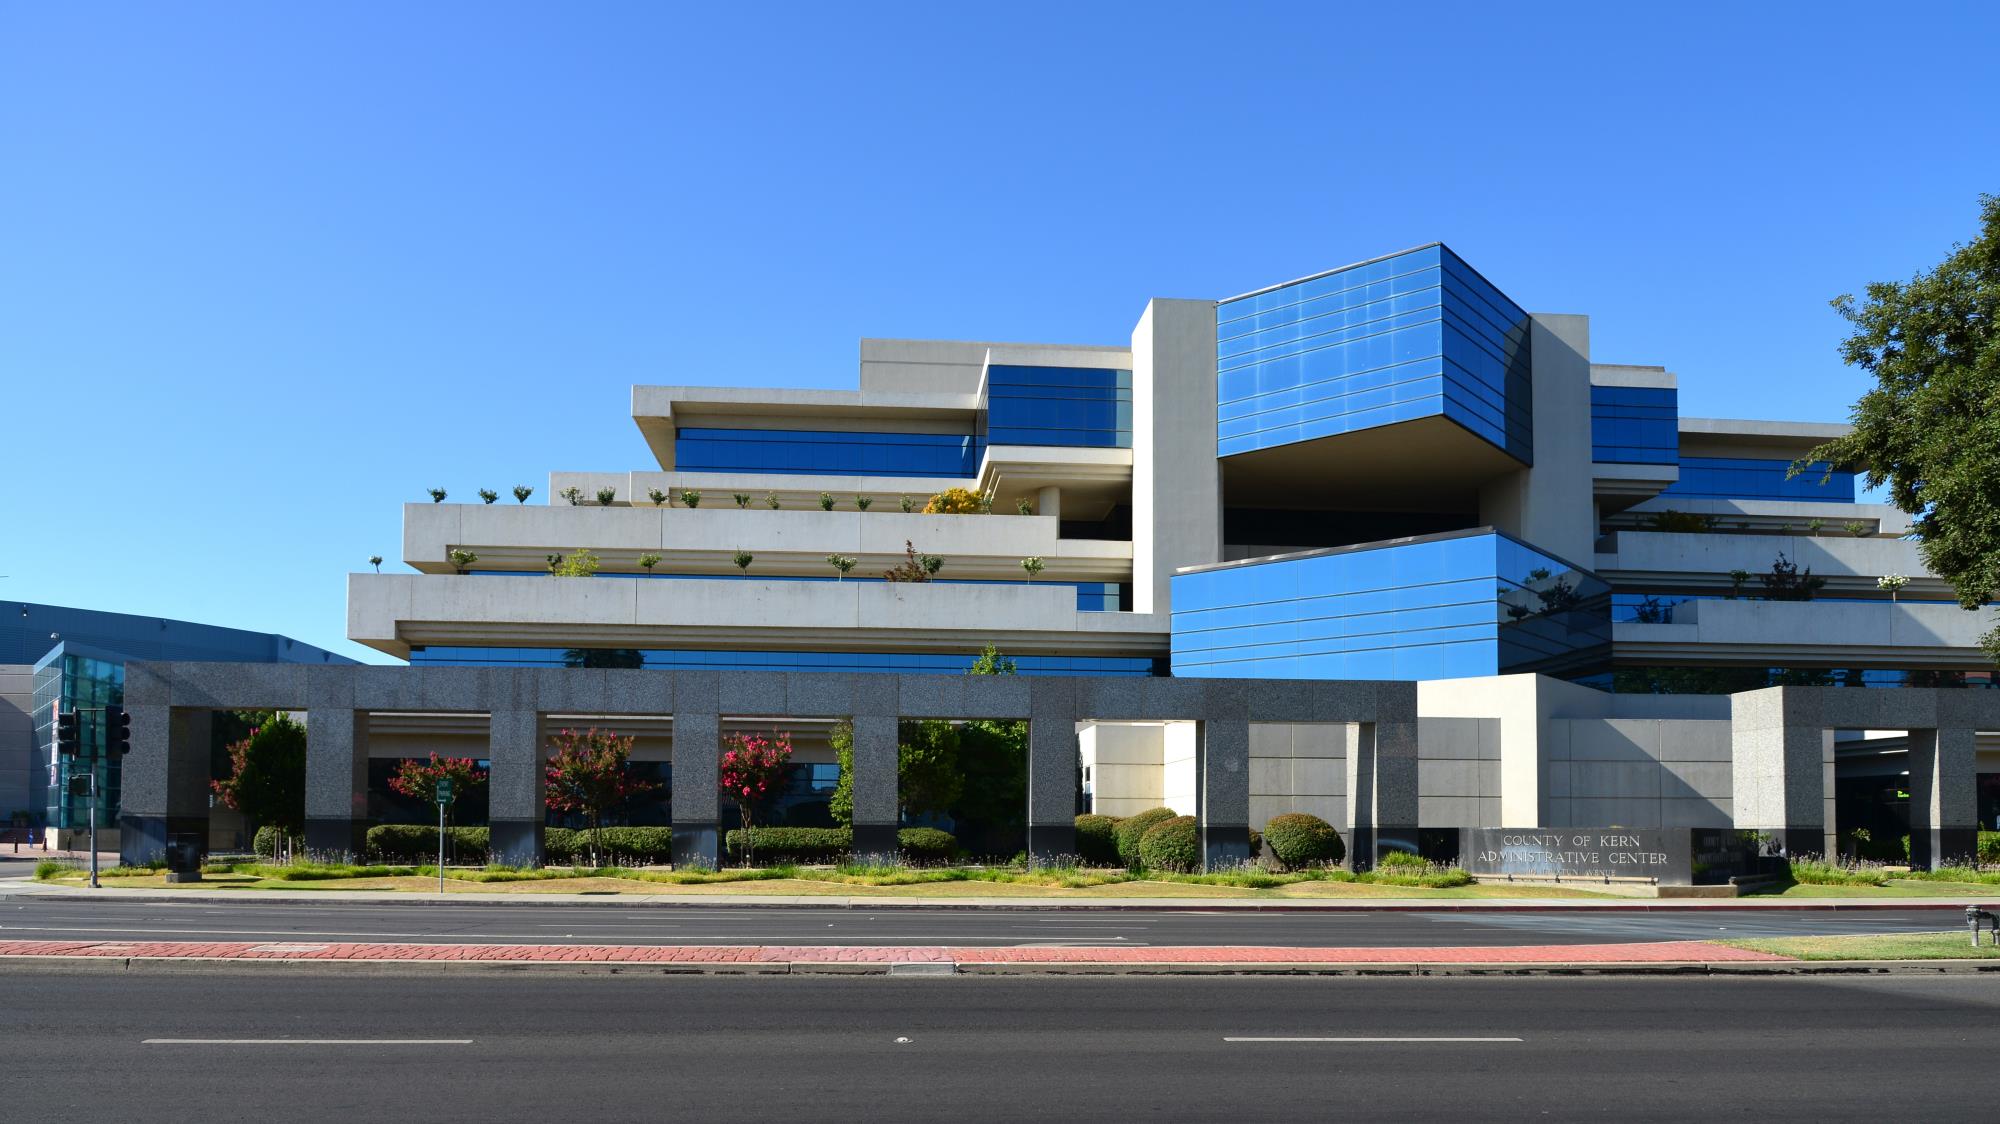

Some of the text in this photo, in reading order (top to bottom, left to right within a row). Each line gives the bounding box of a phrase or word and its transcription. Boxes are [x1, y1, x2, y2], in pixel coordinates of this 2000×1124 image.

[1503, 834, 1640, 847] COUNTY OF KERN
[1478, 850, 1668, 865] ADMINISTRATIVE CENTER
